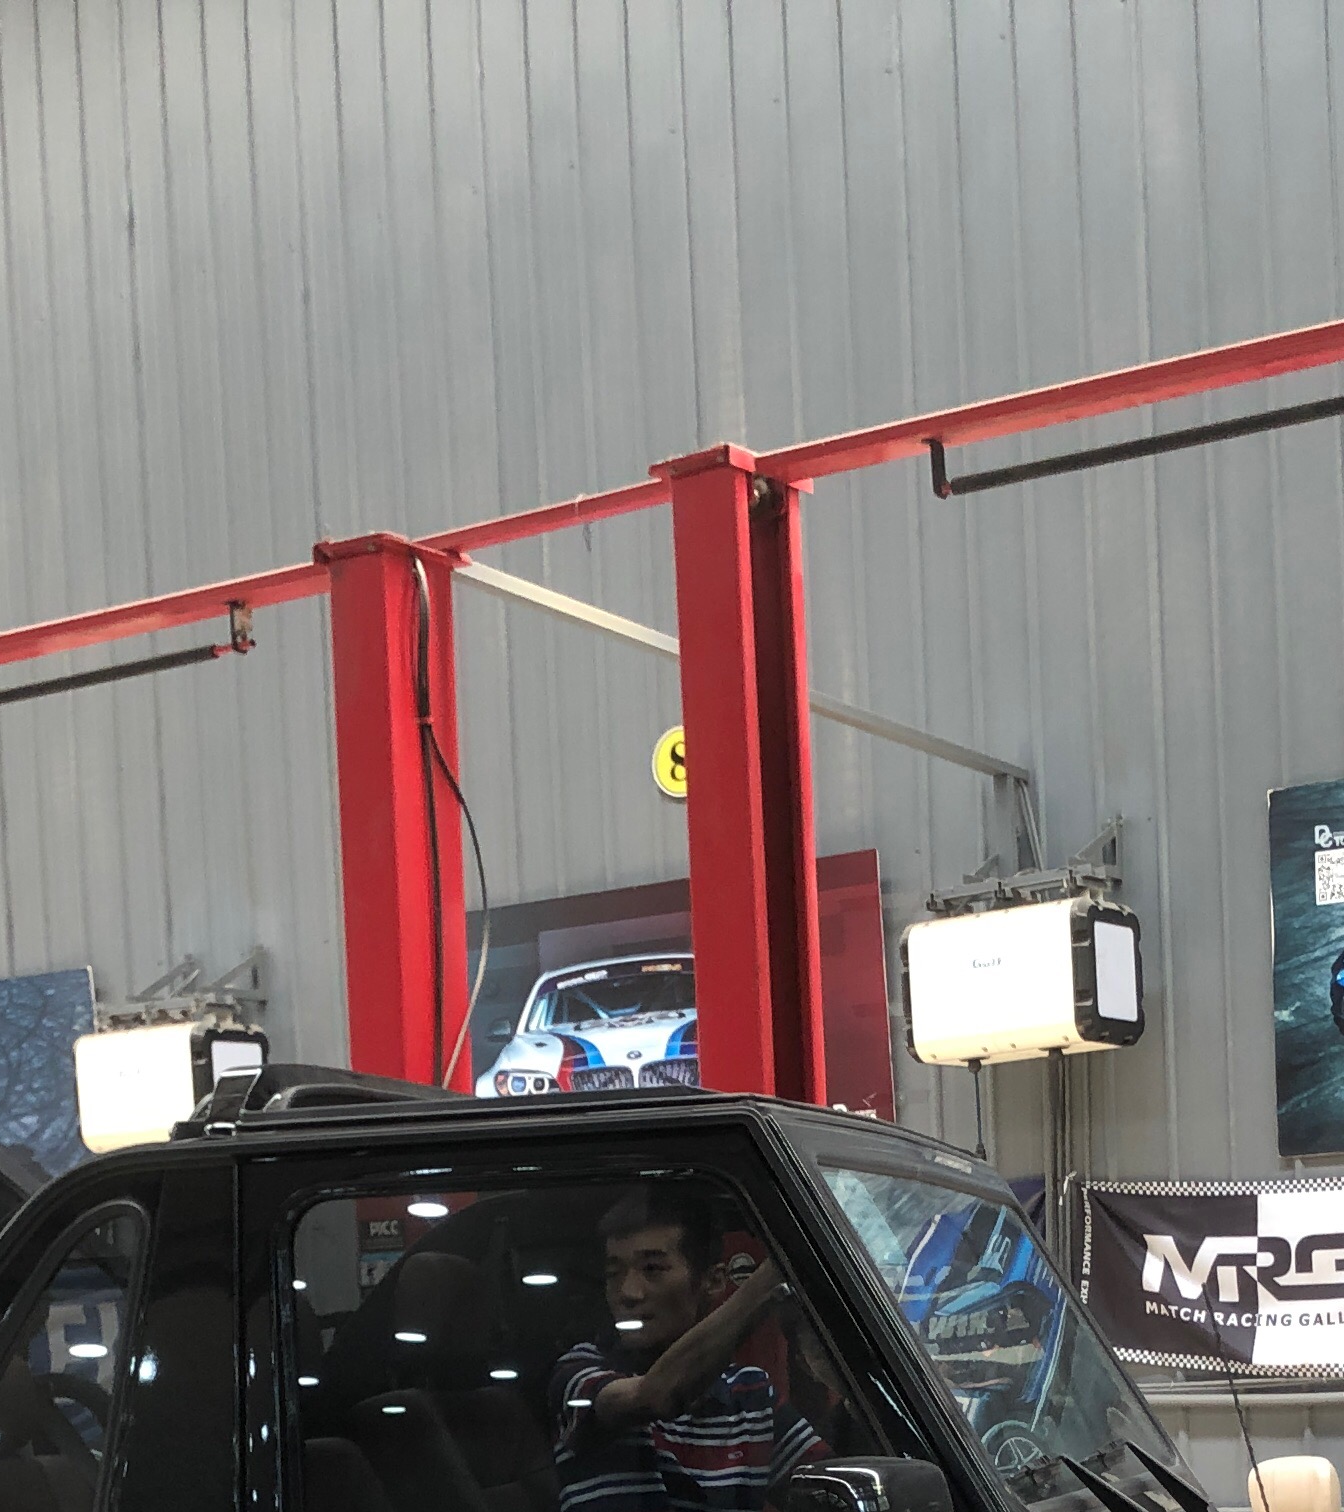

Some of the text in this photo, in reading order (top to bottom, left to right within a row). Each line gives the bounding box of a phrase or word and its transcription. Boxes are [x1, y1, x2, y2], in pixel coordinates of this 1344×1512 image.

[670, 740, 685, 783] 8
[1144, 1300, 1207, 1324] MATCH
[1213, 1311, 1292, 1328] RACING
